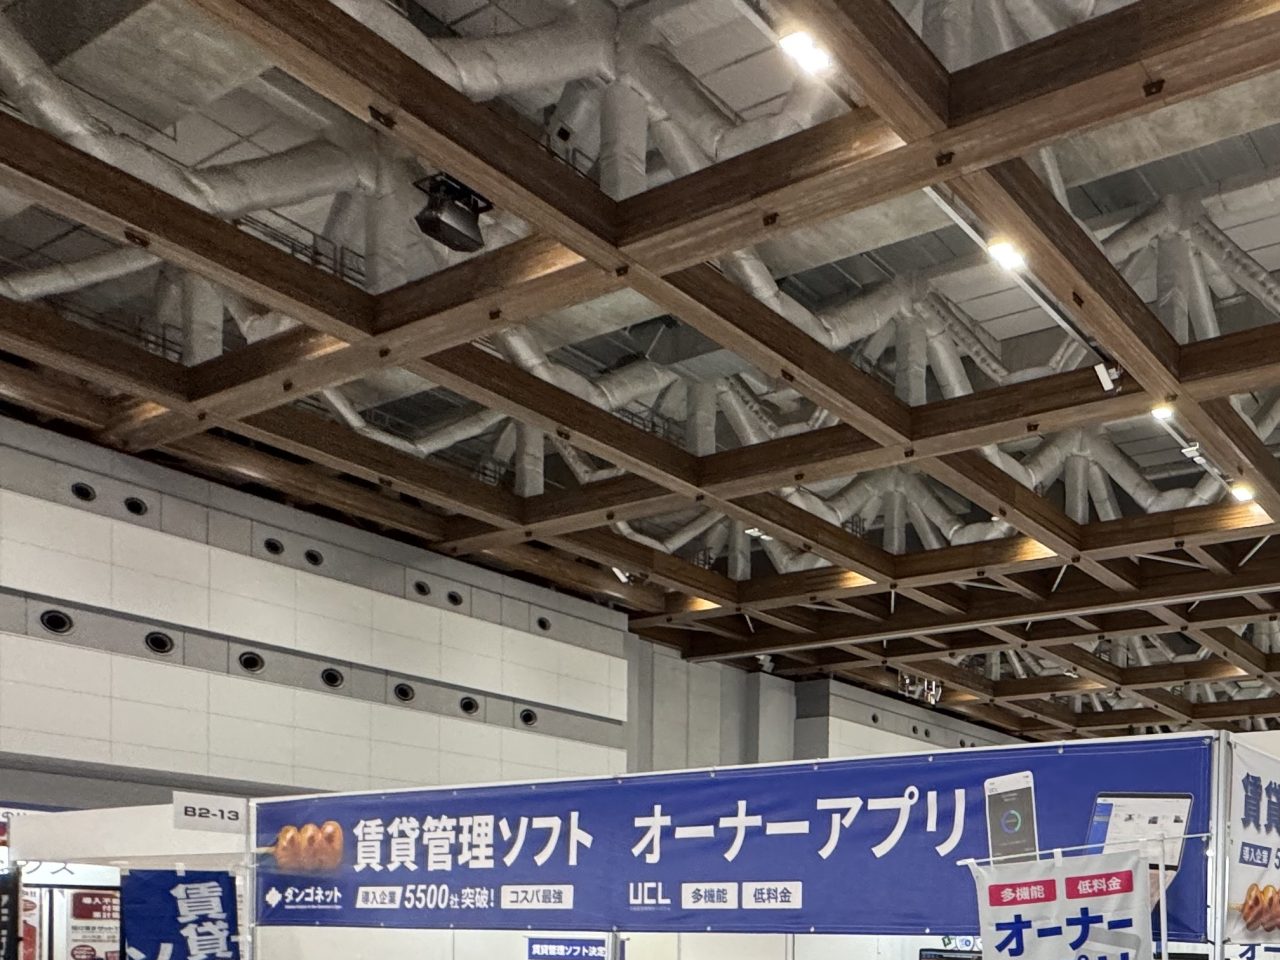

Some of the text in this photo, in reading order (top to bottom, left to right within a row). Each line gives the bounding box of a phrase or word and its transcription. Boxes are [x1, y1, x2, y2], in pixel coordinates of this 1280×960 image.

[183, 805, 240, 822] B2-13
[630, 785, 966, 864] オーナーアプリ
[353, 810, 594, 873] 賃貸管理ソフト
[1242, 845, 1269, 865] 導入企業
[284, 886, 342, 904] ダンゴネット
[361, 891, 397, 906] 導入企業
[629, 881, 792, 906] UCL 多機能 低料金
[1000, 876, 1122, 902] 多機能 低料金
[994, 906, 1134, 958] オーナー
